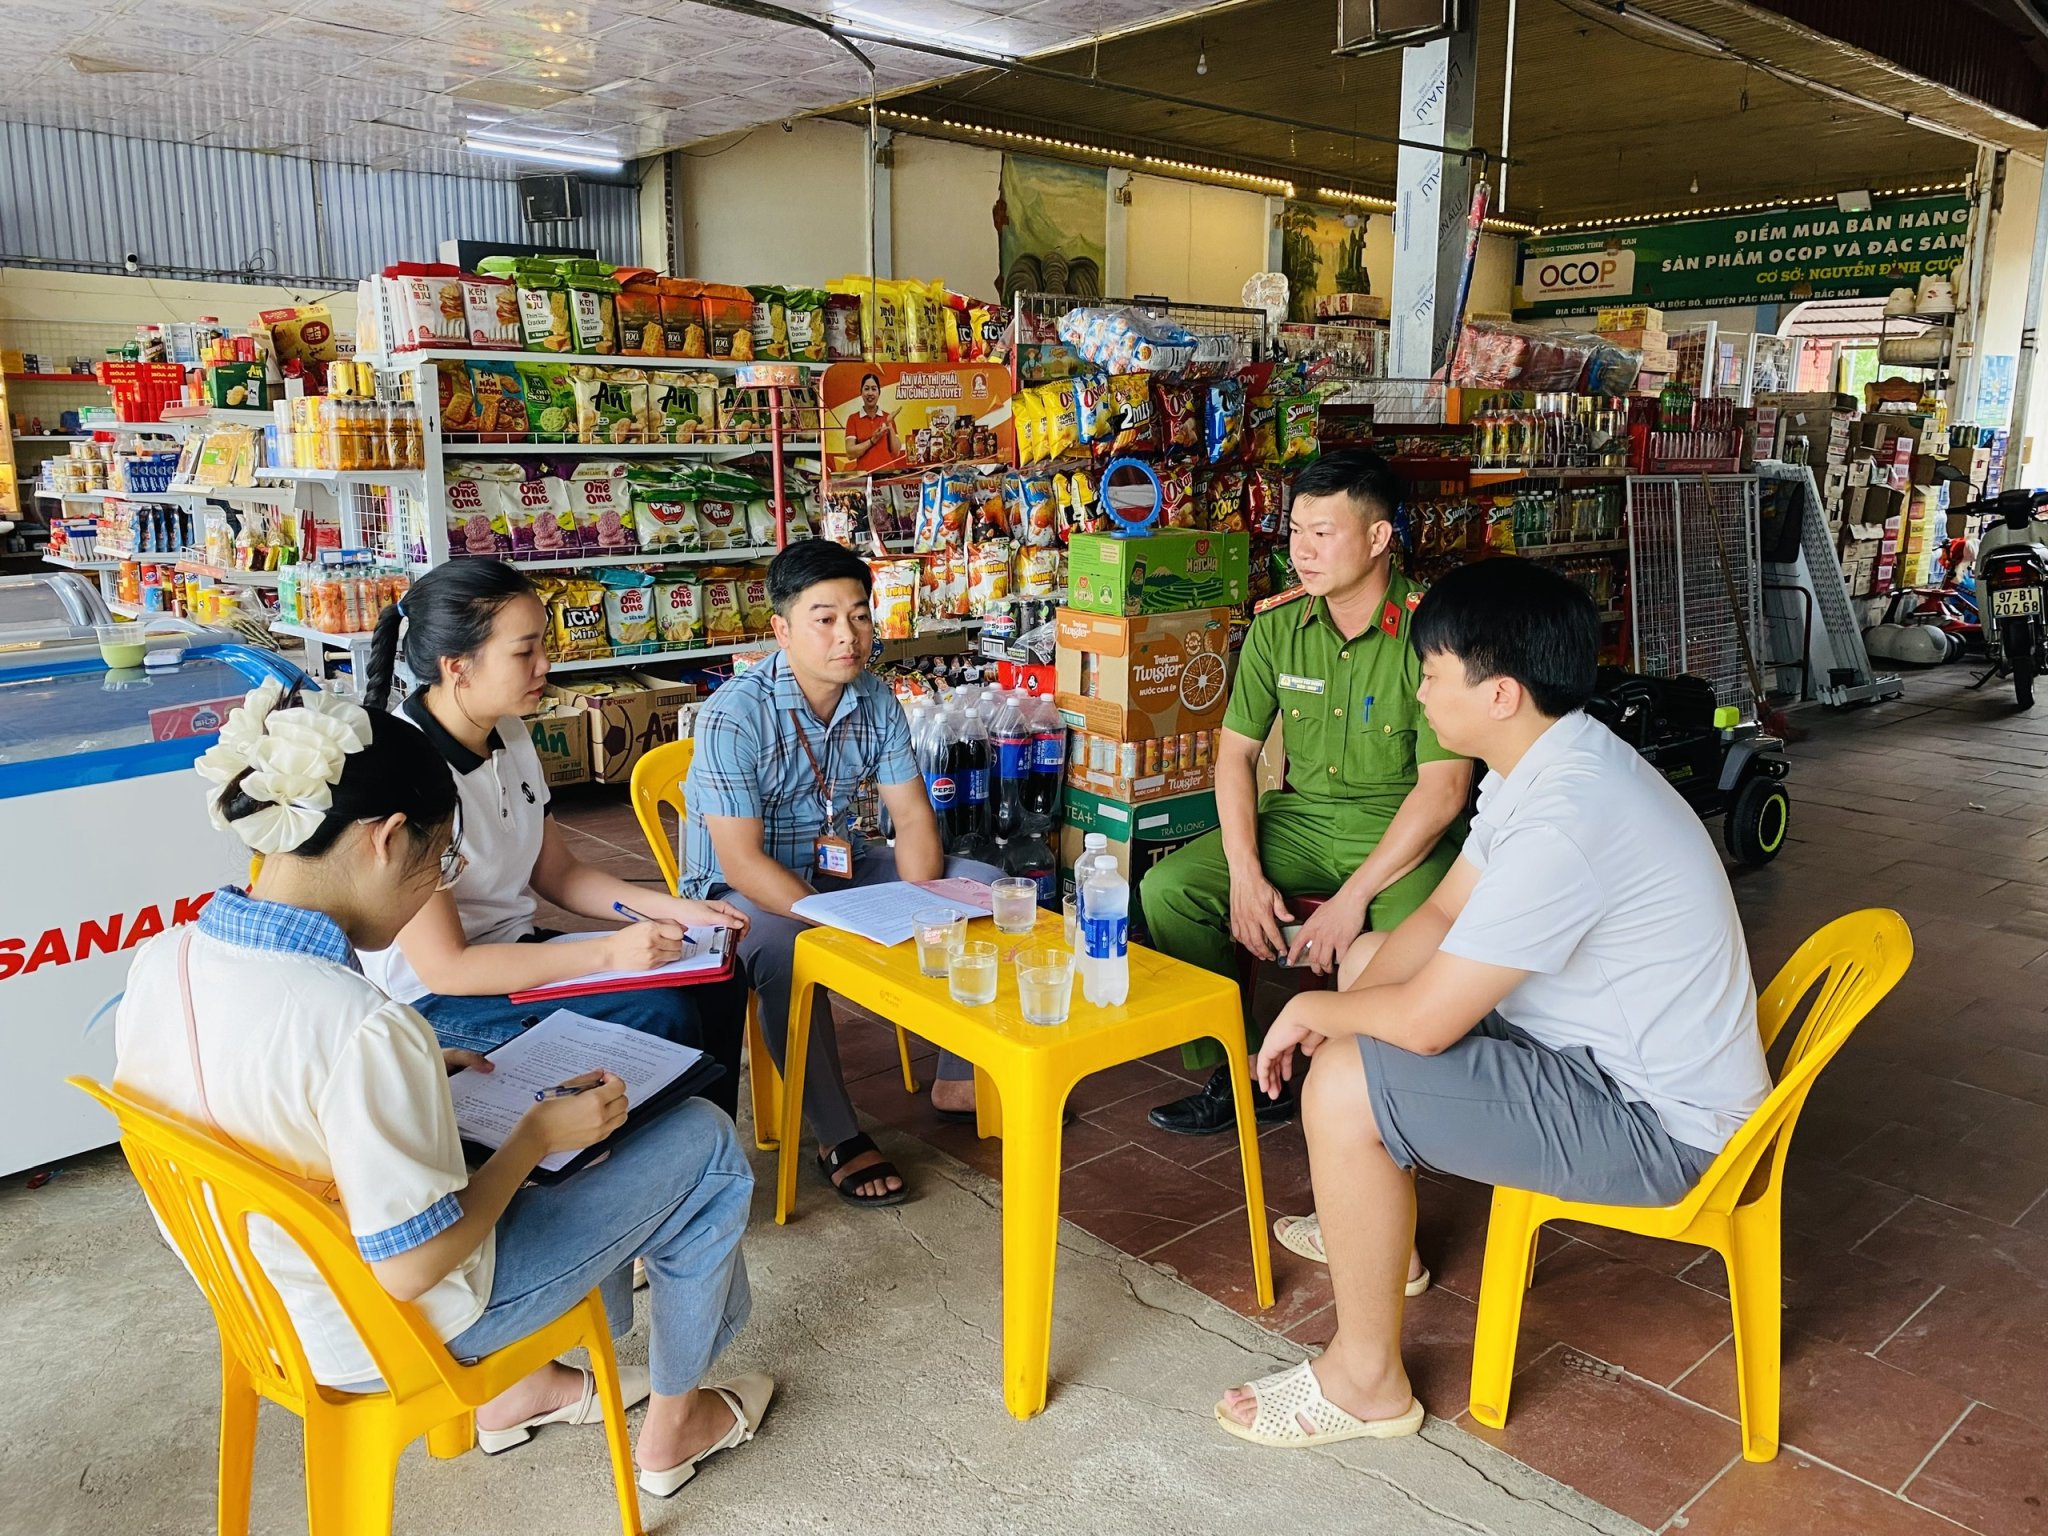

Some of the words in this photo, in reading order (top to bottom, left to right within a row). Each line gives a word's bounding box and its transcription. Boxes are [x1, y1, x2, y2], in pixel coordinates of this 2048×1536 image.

[1735, 222, 1787, 243] ĐIỂM
[1792, 220, 1840, 238] MUA
[1846, 214, 1892, 234] BÁN
[1898, 209, 1968, 229] HÀNG
[1661, 254, 1700, 272] SẢN
[1705, 248, 1763, 269] PHẨM
[1768, 245, 1827, 264] OCOP
[1833, 240, 1861, 258] VÀ
[1867, 237, 1913, 256] ĐẶC
[1918, 232, 1966, 251] SẢN
[1539, 259, 1617, 288] OCOP
[1756, 269, 1778, 284] CƠ
[411, 283, 429, 292] KEN
[468, 288, 486, 296] KEN
[421, 292, 431, 300] JU
[477, 296, 488, 305] JU
[525, 293, 543, 302] KEN
[533, 301, 544, 310] JU
[579, 299, 594, 307] KEN
[586, 307, 595, 315] JU
[527, 393, 546, 401] Sen
[590, 381, 628, 413] An
[657, 385, 694, 413] An
[1249, 407, 1276, 429] Swing
[1286, 403, 1315, 423] Swing
[448, 485, 480, 499] One
[519, 482, 547, 495] One
[583, 481, 611, 494] One
[452, 497, 483, 509] One
[521, 494, 550, 506] One
[586, 493, 613, 506] One
[661, 504, 683, 515] One
[702, 502, 723, 514] One
[712, 508, 731, 519] One
[1185, 556, 1218, 573] MATCHA
[670, 590, 692, 599] One
[709, 588, 729, 597] One
[746, 586, 765, 595] One
[620, 595, 642, 605] One
[711, 597, 731, 607] One
[748, 594, 765, 604] One
[1998, 590, 2034, 604] 97-B1
[621, 604, 644, 614] One
[671, 599, 693, 609] One
[1995, 600, 2040, 616] 202.68
[570, 629, 599, 641] Mini
[1060, 624, 1091, 639] Twister
[1154, 654, 1179, 666] Tropicana
[1132, 663, 1185, 684] Twister
[1156, 686, 1169, 695] CAM
[532, 722, 571, 758] An
[1167, 775, 1204, 791] Twister
[932, 786, 955, 794] PEPSI
[1064, 804, 1094, 825] TEA+
[1175, 823, 1182, 834] Ô
[1183, 820, 1206, 833] LONG
[0, 883, 254, 981] SANAK
